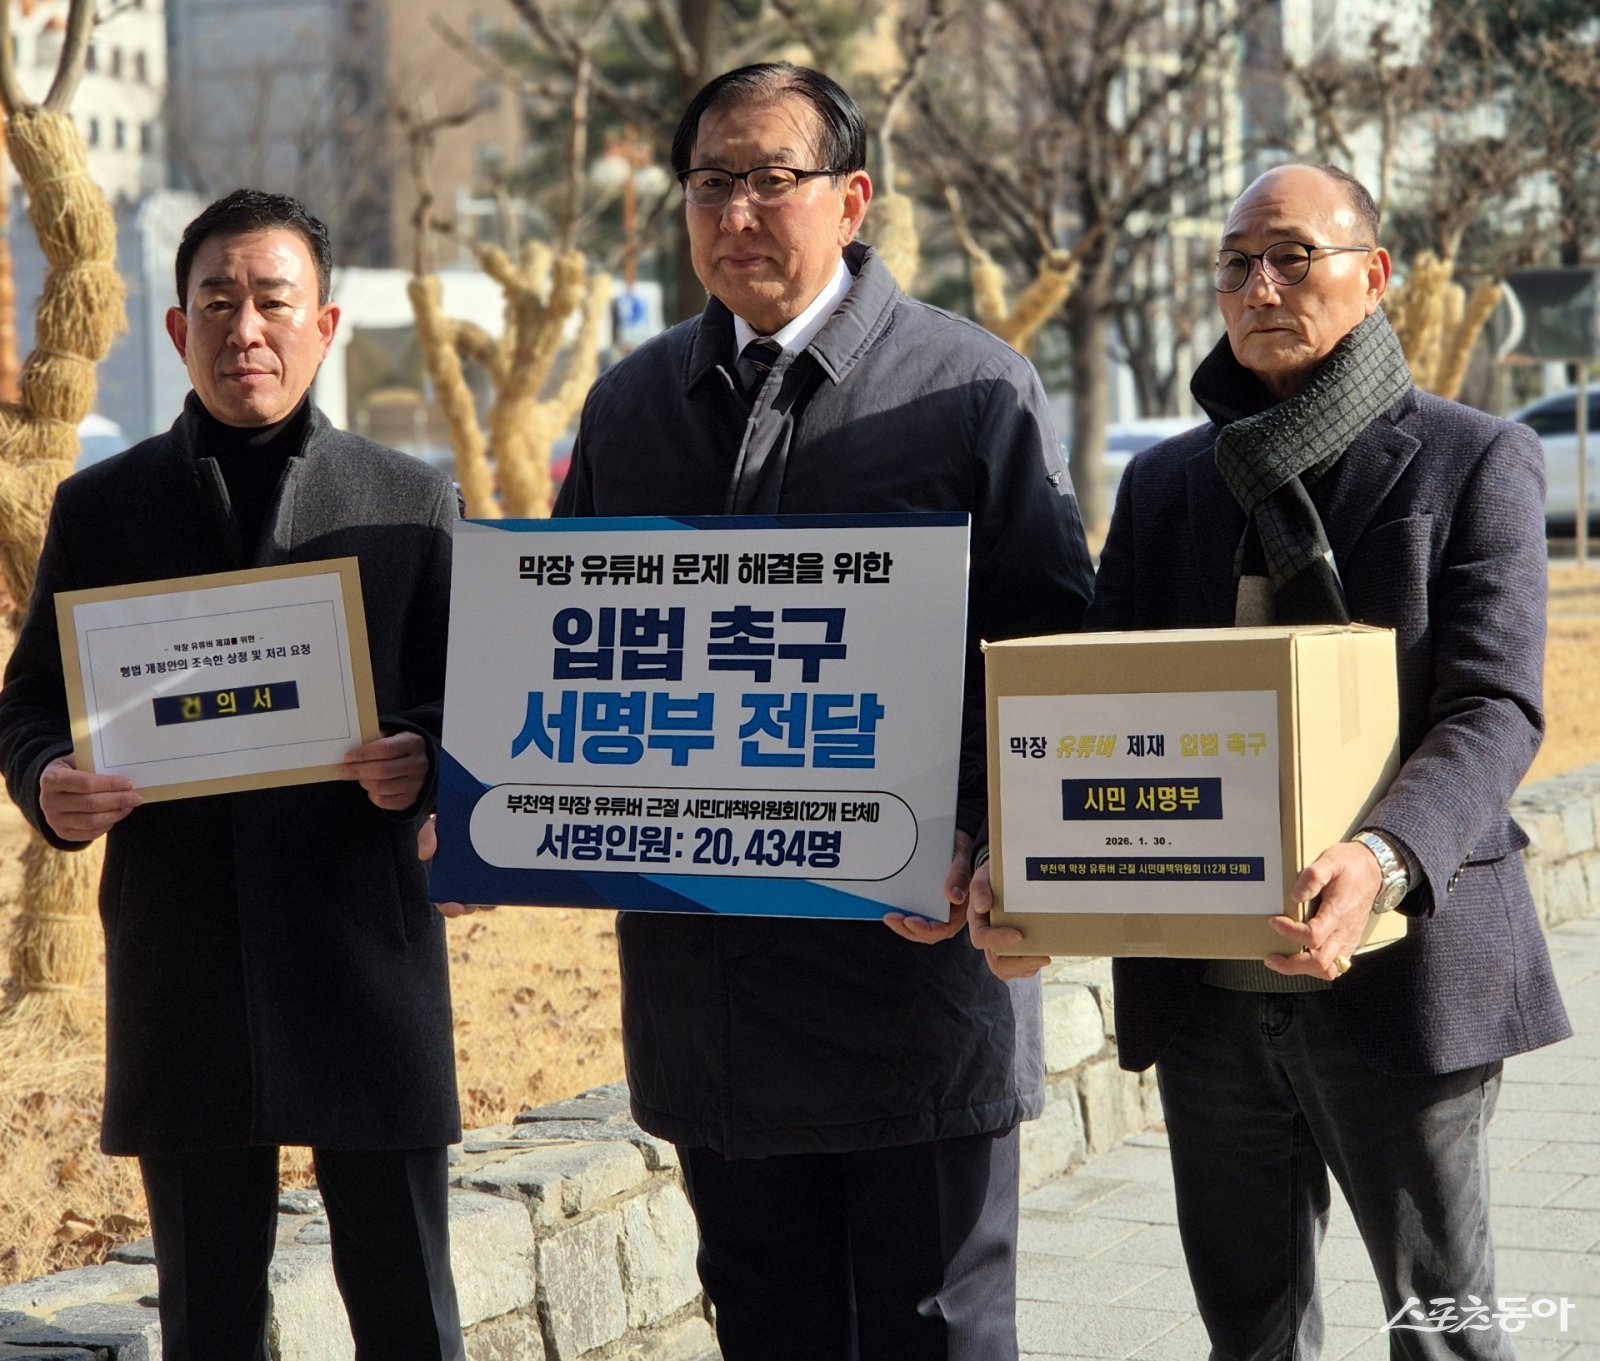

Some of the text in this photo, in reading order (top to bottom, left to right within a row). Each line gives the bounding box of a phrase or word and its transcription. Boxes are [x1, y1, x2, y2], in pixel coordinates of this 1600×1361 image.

[519, 551, 894, 586] 막장 유튜버 문제 해결을 위한
[191, 640, 213, 651] 유튜버
[552, 605, 848, 683] 입법 촉구
[120, 643, 311, 678] 형법 개정안의 조속한 상정 및 처리 요청
[511, 690, 885, 770] 서명부 전달
[1010, 733, 1267, 759] 막장 유튜버 제재 입법 촉구
[507, 794, 555, 815] 부천역
[558, 796, 591, 816] 막장
[594, 797, 643, 817] 유튜버
[646, 798, 679, 818] 근절
[840, 802, 880, 823] 단체)
[1083, 786, 1201, 812] 시민 서명부
[536, 823, 842, 869] 서명인원: 20,434명
[1105, 837, 1133, 846] 2026.
[1138, 837, 1148, 846] 1.
[1040, 863, 1251, 875] 부천역 막장 유튜버 근절 시민대책위원회 (12개 단체)
